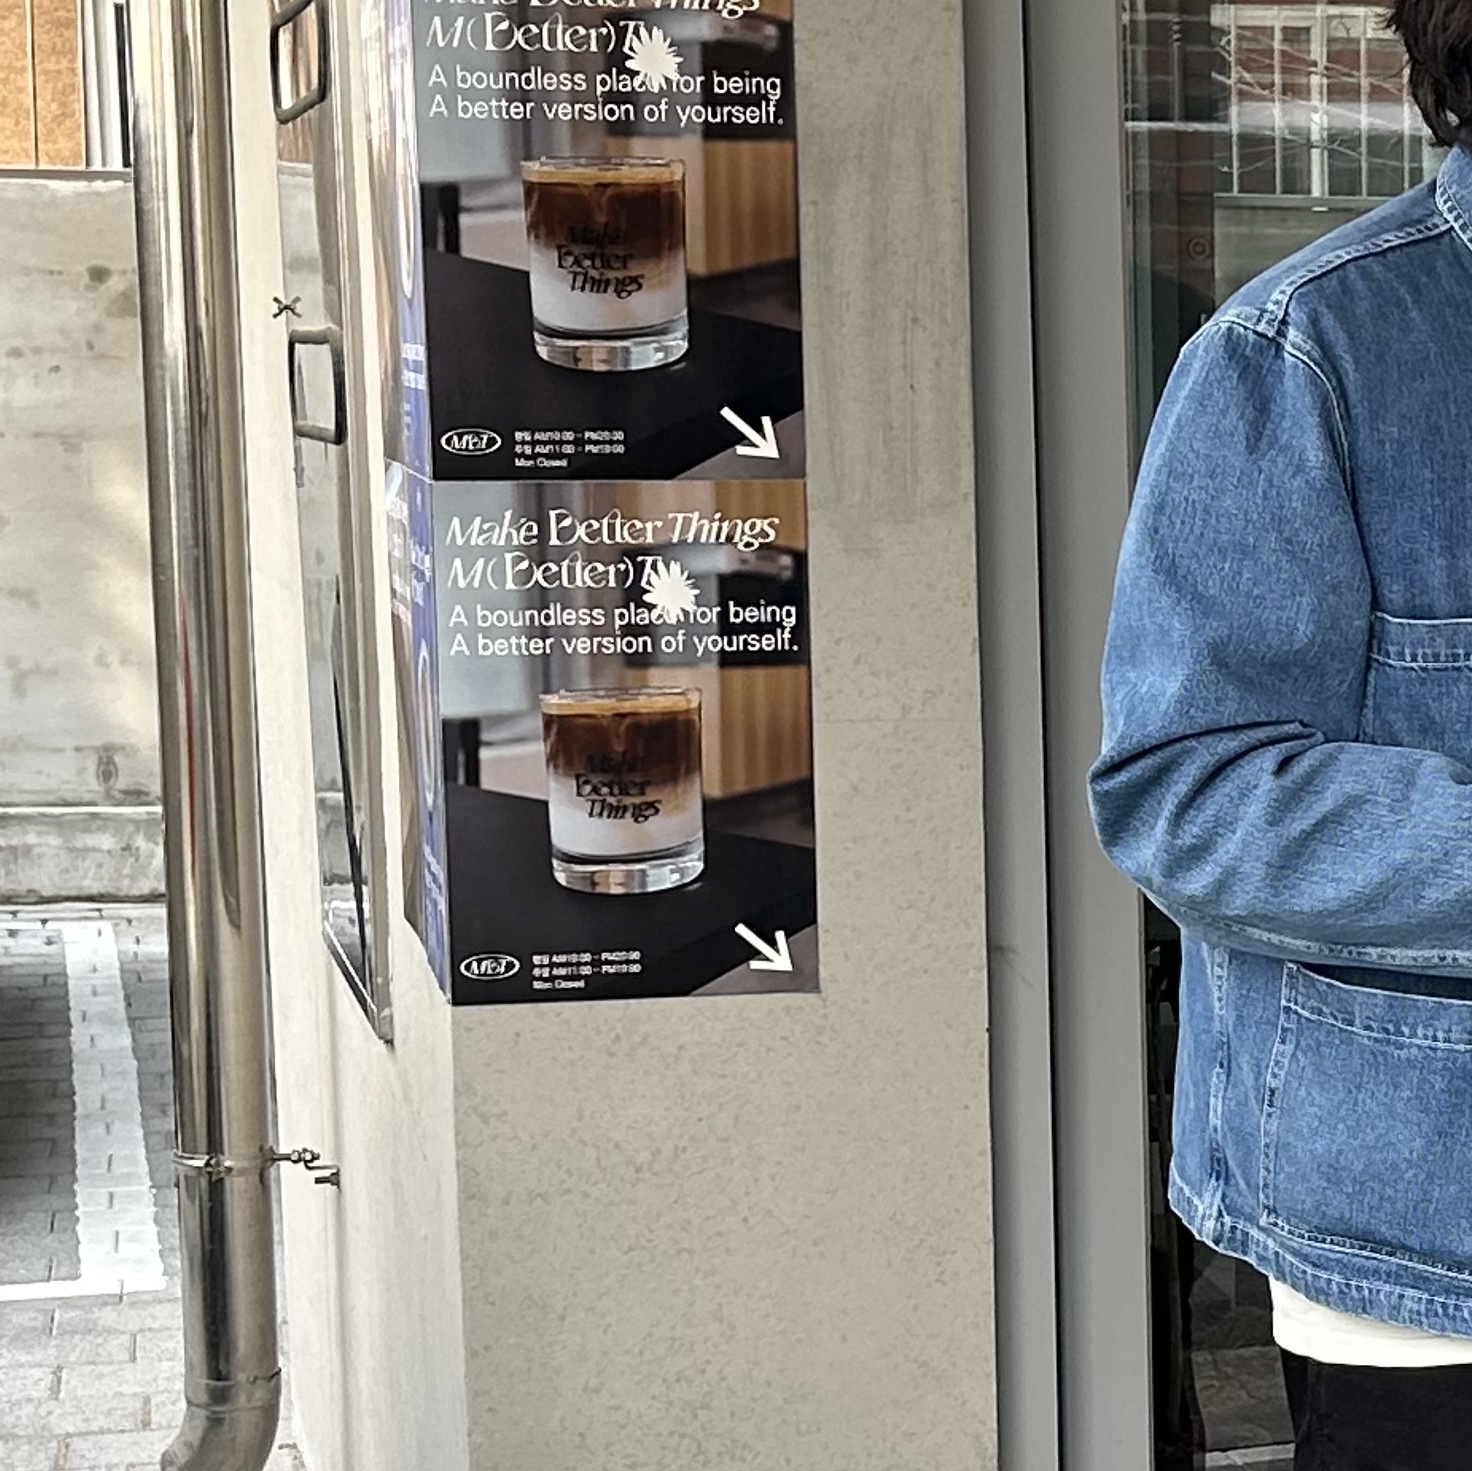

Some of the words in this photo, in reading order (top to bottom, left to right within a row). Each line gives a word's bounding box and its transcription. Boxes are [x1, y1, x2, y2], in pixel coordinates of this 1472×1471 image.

[429, 64, 447, 87] A
[456, 65, 587, 91] boundless
[596, 66, 659, 97] plac
[713, 70, 781, 98] being
[429, 95, 448, 118] A
[457, 95, 534, 119] better
[543, 98, 635, 121] version
[644, 98, 669, 121] of
[676, 100, 784, 127] yourself.
[568, 270, 645, 299] Things
[445, 509, 538, 546] Make
[549, 508, 664, 546] Better
[667, 511, 780, 551] Things
[449, 605, 468, 627] A
[477, 602, 605, 627] boundless
[613, 602, 677, 634] plac
[729, 600, 797, 628] being
[450, 633, 470, 656] A
[478, 633, 554, 656] better
[562, 632, 652, 654] version
[661, 629, 686, 653] of
[693, 627, 800, 656] yourself.
